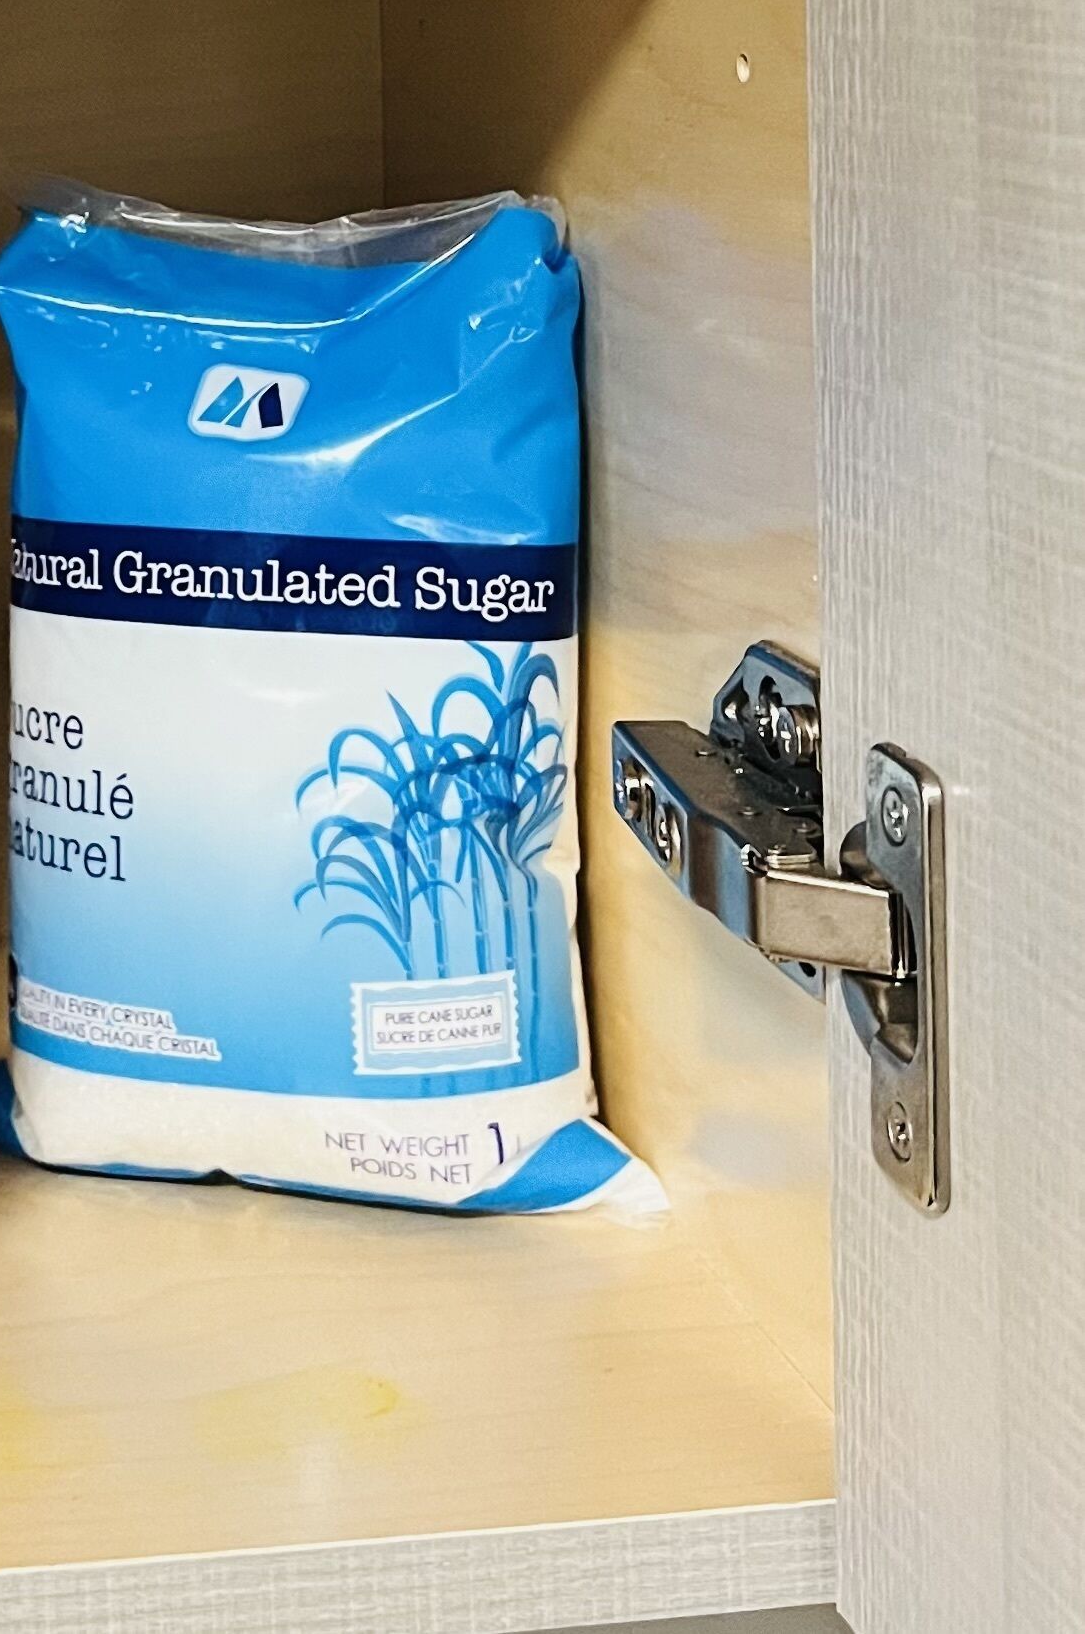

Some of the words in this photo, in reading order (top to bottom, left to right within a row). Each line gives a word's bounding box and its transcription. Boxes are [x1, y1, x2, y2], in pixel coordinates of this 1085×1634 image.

[11, 538, 103, 590] atural
[112, 549, 401, 608] Granulated
[414, 566, 555, 623] Sugar
[12, 702, 83, 750] ucre
[10, 759, 134, 820] ranulé
[10, 816, 126, 882] aturel
[112, 1006, 174, 1030] CRYSTAL
[385, 1012, 415, 1024] PURE
[418, 1009, 452, 1024] CANE
[455, 1005, 493, 1021] SUGAR
[158, 1035, 219, 1056] CRISTAL
[377, 1031, 415, 1044] SUCRE
[419, 1030, 434, 1042] DE
[437, 1025, 478, 1041] CANNE
[482, 1023, 501, 1036] PUR
[325, 1130, 365, 1151] NET
[381, 1133, 469, 1157] WEIGHT
[350, 1156, 417, 1180] POIDS
[430, 1163, 473, 1185] NET
